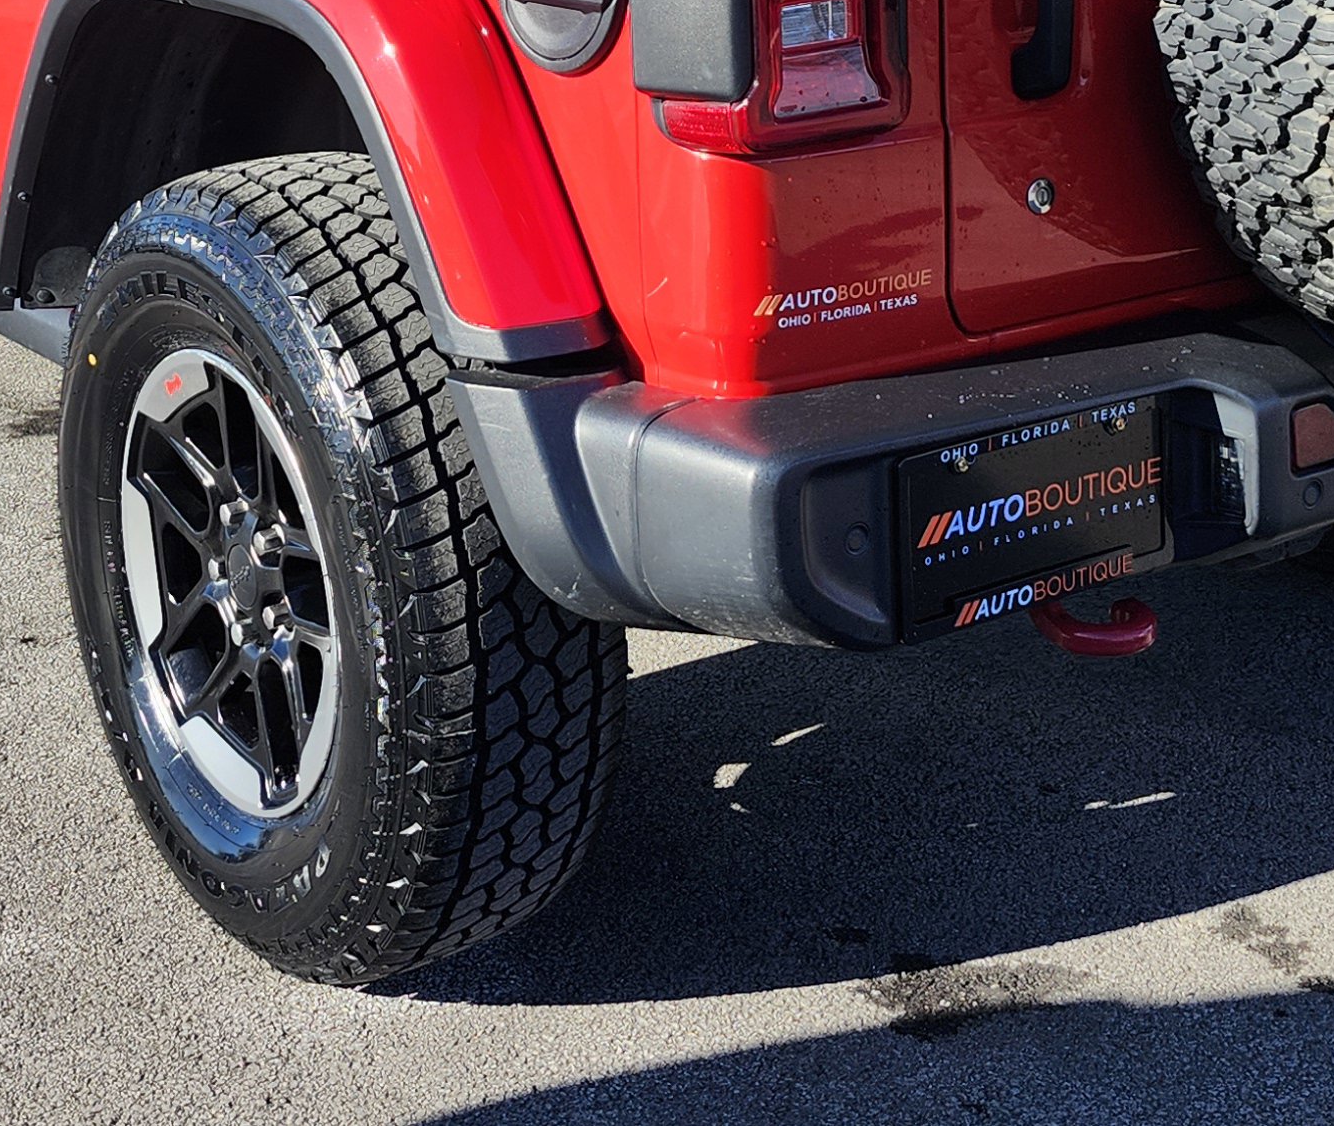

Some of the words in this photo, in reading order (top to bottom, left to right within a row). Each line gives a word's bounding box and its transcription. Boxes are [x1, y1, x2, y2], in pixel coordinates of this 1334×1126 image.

[778, 313, 811, 329] OHIO
[820, 303, 872, 322] FLORIDA
[879, 294, 918, 311] TEXAS
[779, 268, 932, 312] AUTOBOUTIQUE
[940, 442, 979, 463] OHIO
[1001, 419, 1071, 447] FLORIDA
[1091, 401, 1136, 423] TEXAS
[924, 545, 969, 566] OHIO
[993, 516, 1073, 546] FLORIDA
[1099, 493, 1157, 517] TEXAS
[944, 457, 1162, 540] AUTOBOUTIQUE
[974, 553, 1135, 621] AUTOBOUTIQUE
